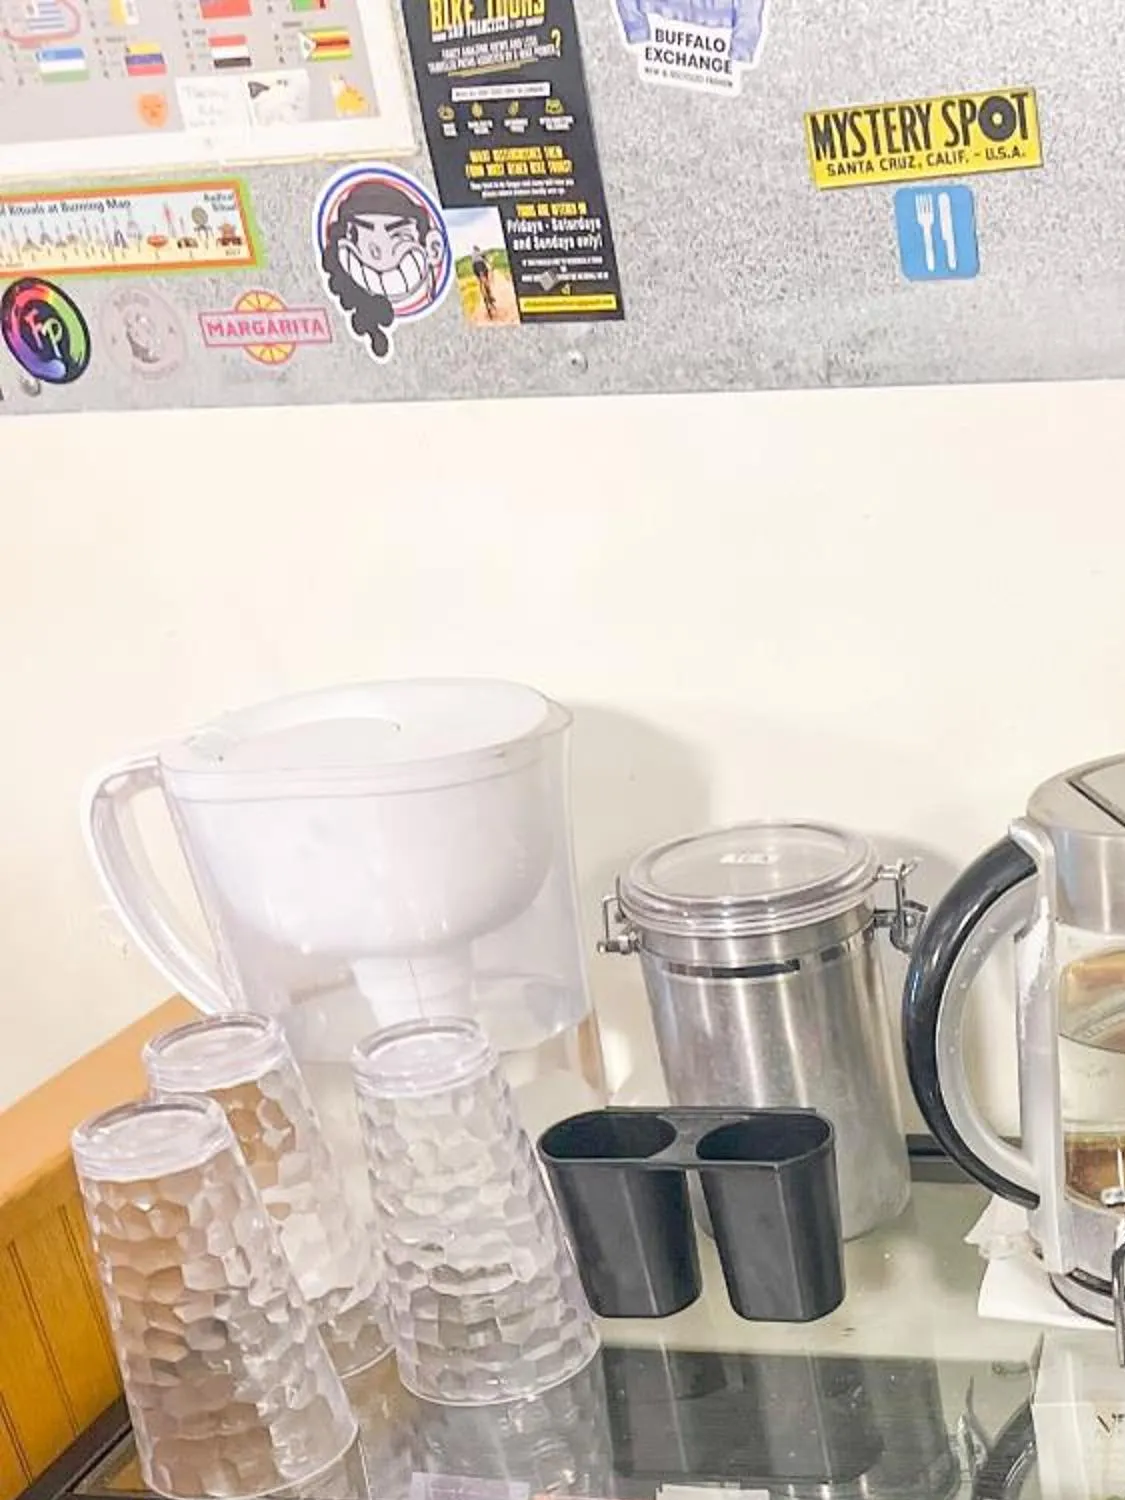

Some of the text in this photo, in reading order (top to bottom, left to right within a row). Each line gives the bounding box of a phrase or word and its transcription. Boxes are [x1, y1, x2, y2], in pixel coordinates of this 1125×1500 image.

[655, 28, 726, 53] BUFFALO
[645, 47, 733, 75] EXCHANGE
[810, 92, 1029, 161] MYSTERY SPOT
[826, 160, 875, 177] SANTA
[879, 156, 922, 172] CRUZ,
[928, 150, 969, 167] CALIF.
[985, 146, 1026, 161] U.S.A.
[207, 316, 326, 338] MARGARITA
